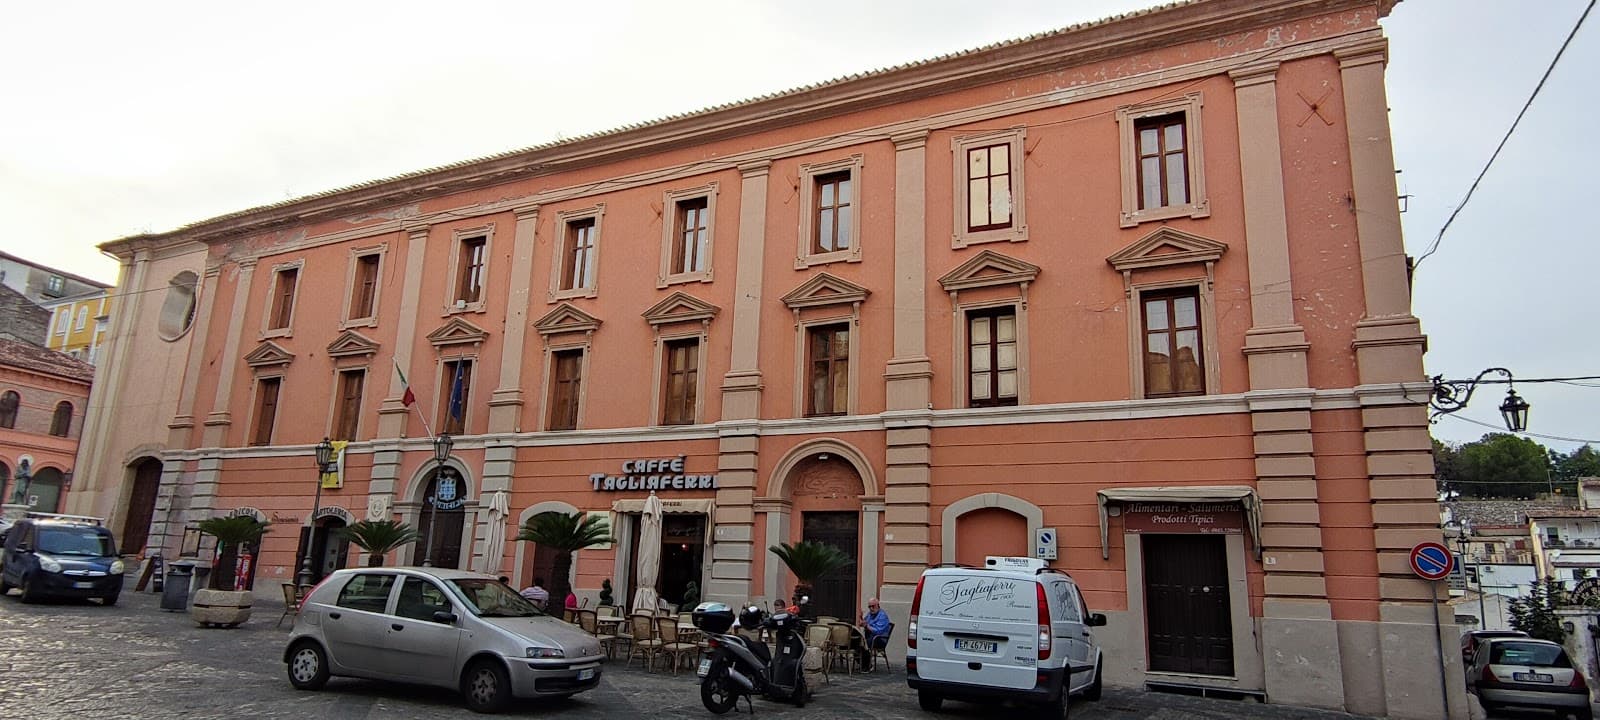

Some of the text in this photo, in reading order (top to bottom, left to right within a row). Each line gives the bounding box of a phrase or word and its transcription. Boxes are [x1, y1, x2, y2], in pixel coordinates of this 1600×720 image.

[589, 473, 719, 490] TAGLIAFERRI
[1126, 503, 1179, 513] Alimentari
[1188, 503, 1241, 513] Salumeria
[1152, 515, 1214, 525] Prodotti Tipici
